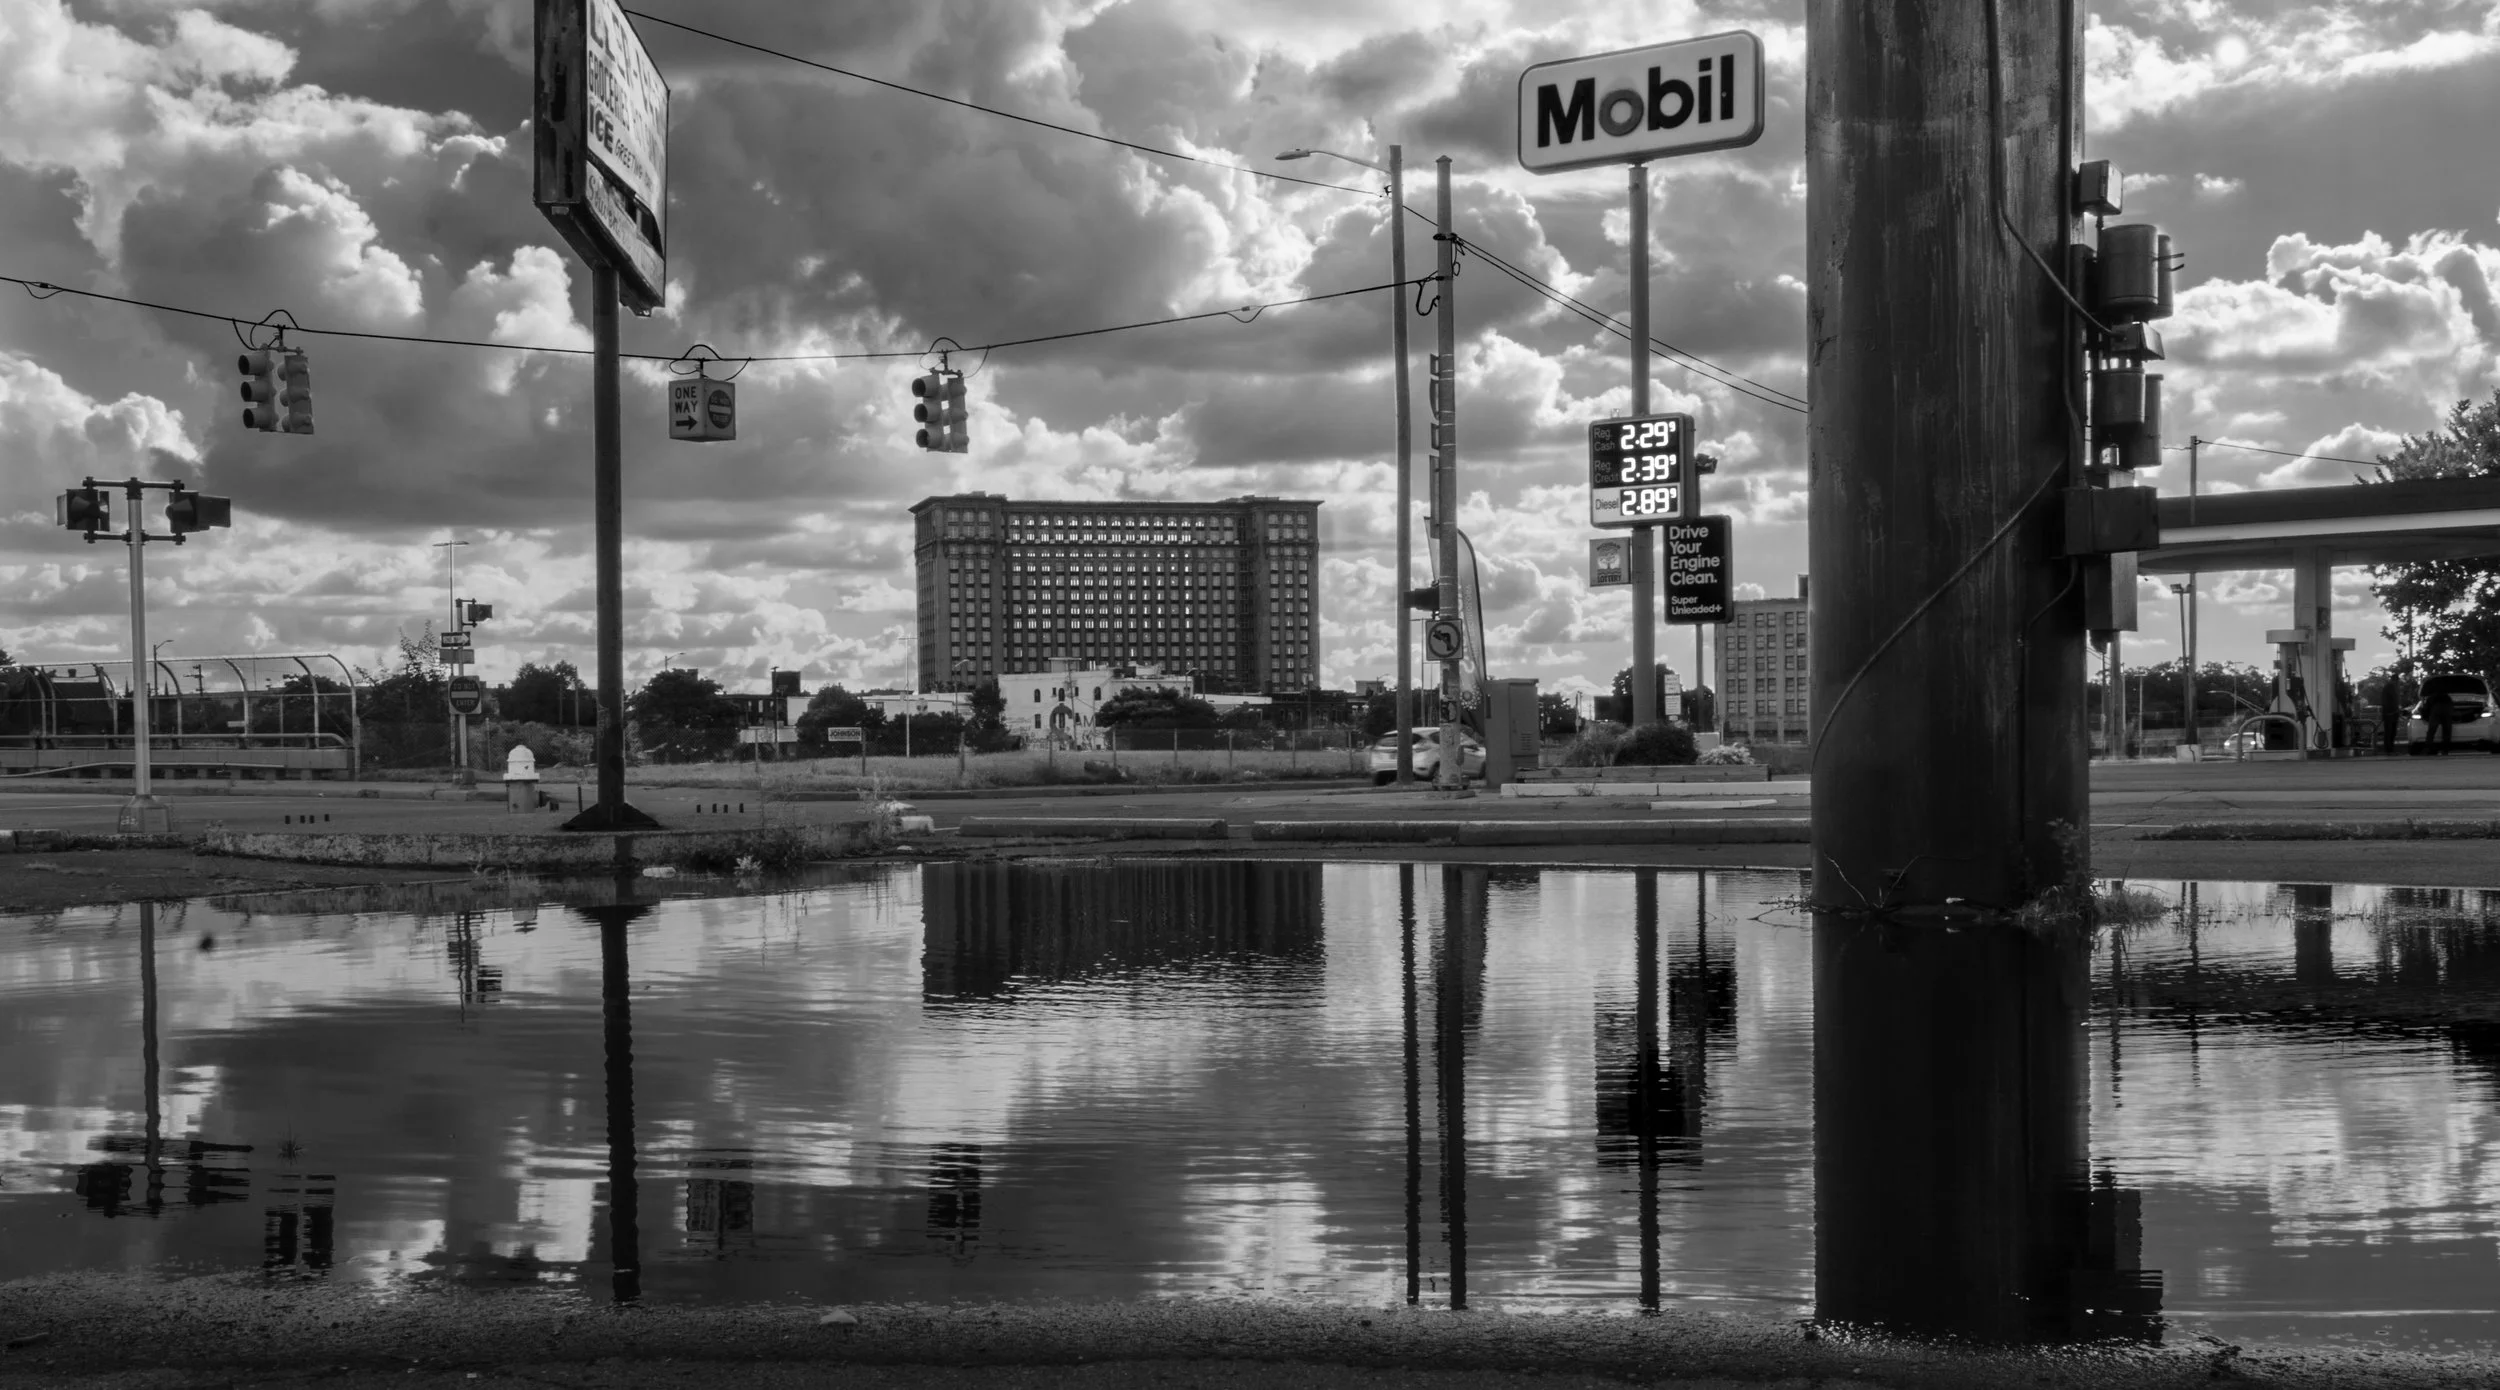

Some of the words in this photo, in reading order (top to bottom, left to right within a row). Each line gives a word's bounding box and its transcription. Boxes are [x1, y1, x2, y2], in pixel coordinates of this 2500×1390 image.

[1537, 53, 1735, 148] Mobil
[589, 102, 614, 154] ICE
[675, 387, 697, 400] ONE
[675, 400, 698, 413] WAY
[1594, 440, 1615, 452] Cash
[1594, 472, 1620, 484] Credit
[1595, 497, 1619, 510] Diesel
[1669, 526, 1709, 540] Drive
[1669, 541, 1702, 554] Your
[1670, 556, 1720, 571] Engine
[1597, 574, 1622, 584] LOTTERY
[1670, 572, 1718, 586] Clean.
[1671, 596, 1698, 606] Super
